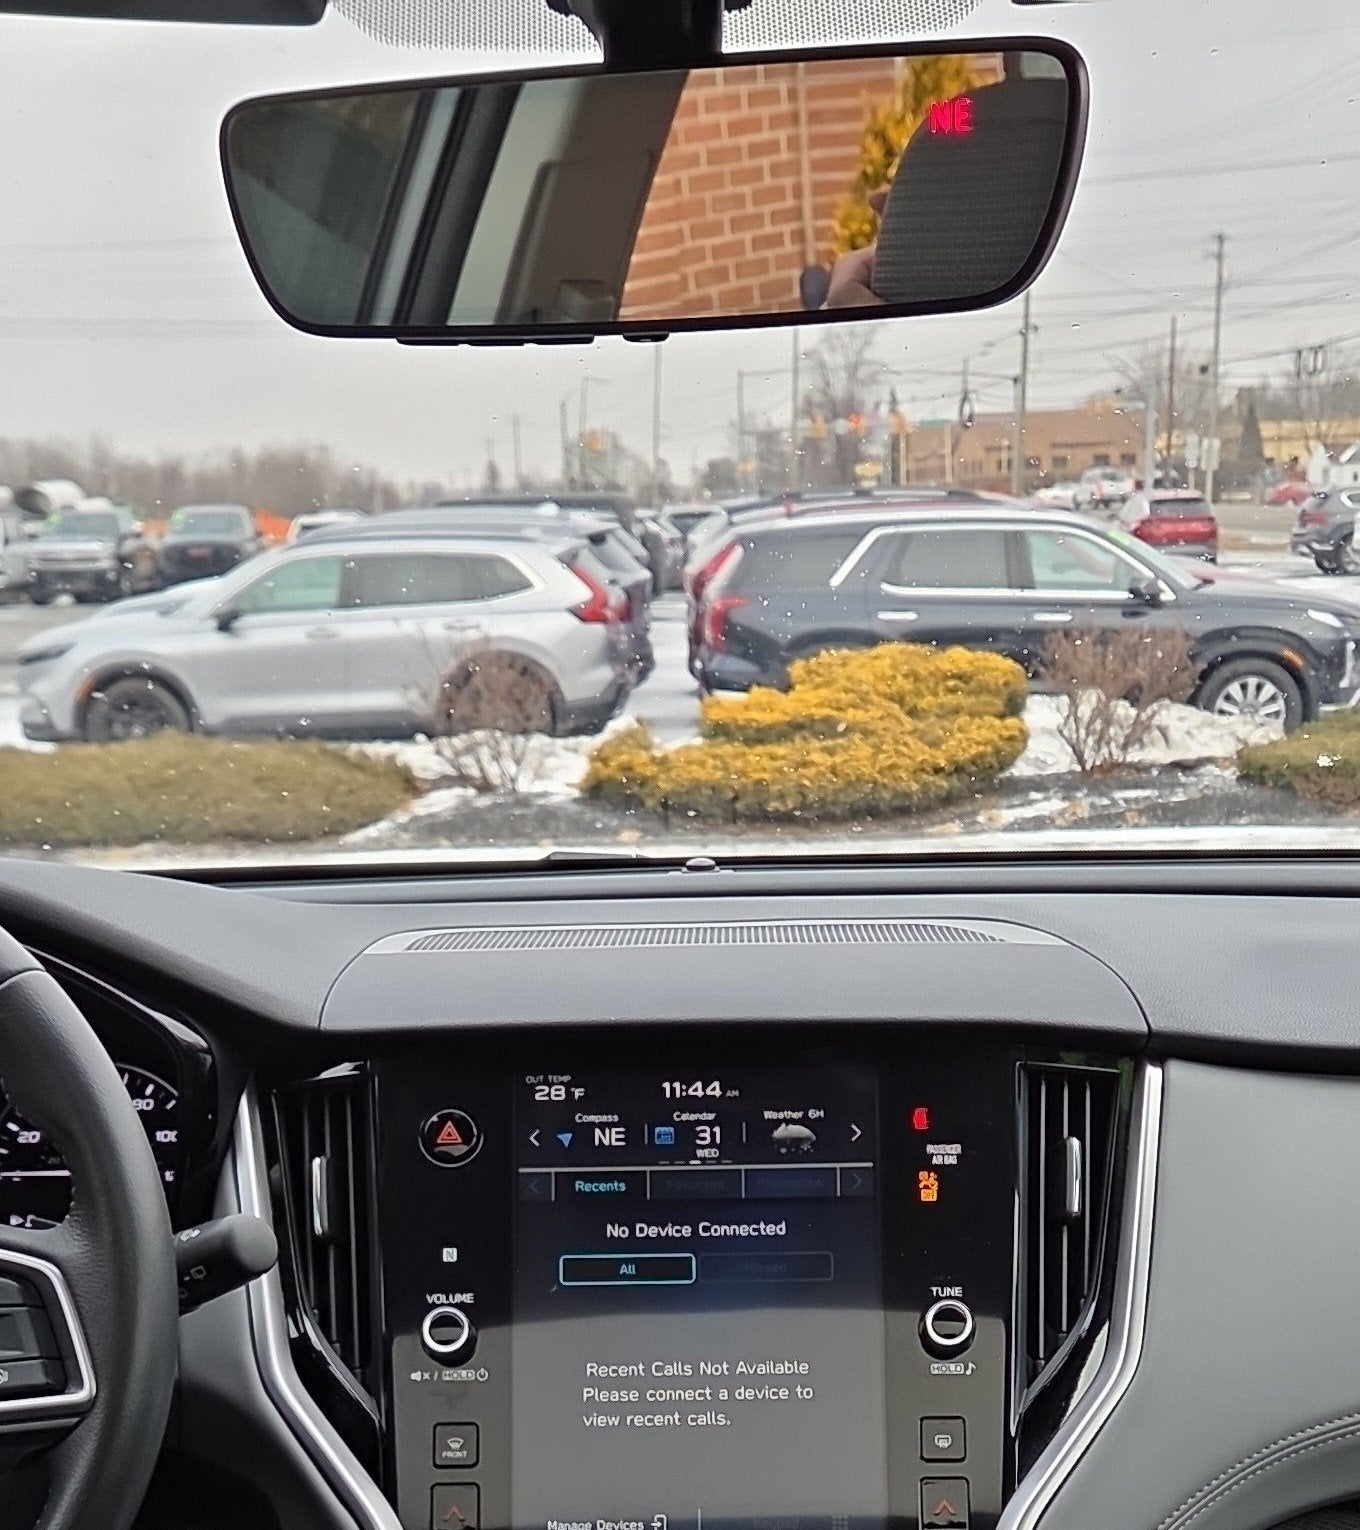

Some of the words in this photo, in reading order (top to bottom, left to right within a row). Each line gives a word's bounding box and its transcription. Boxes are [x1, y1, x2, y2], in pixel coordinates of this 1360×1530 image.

[930, 98, 972, 133] NE
[525, 1075, 544, 1084] OUT
[548, 1075, 571, 1083] TEMP
[534, 1085, 566, 1101] 28
[662, 1080, 723, 1098] 11:44
[725, 1090, 739, 1098] AM
[575, 1112, 619, 1123] Compass
[673, 1111, 716, 1122] Calendar
[763, 1110, 804, 1120] Weather
[808, 1109, 824, 1120] 6H
[17, 1131, 40, 1144] 20
[594, 1127, 627, 1146] NE
[695, 1125, 721, 1145] 31
[696, 1148, 720, 1158] WED
[575, 1180, 627, 1192] Recents
[606, 1223, 629, 1238] No
[635, 1222, 692, 1238] Device
[698, 1220, 787, 1237] Connected
[619, 1263, 636, 1275] All
[930, 1286, 963, 1297] TUNE
[426, 1293, 475, 1304] VOLUME
[586, 1362, 645, 1377] Recent
[651, 1361, 693, 1377] Calls
[699, 1361, 729, 1376] Not
[736, 1359, 810, 1375] Available
[582, 1387, 640, 1402] Please
[646, 1386, 712, 1401] connect
[718, 1388, 729, 1400] a
[735, 1385, 790, 1400] device
[796, 1384, 814, 1399] to
[582, 1413, 620, 1427] view
[626, 1411, 681, 1426] recent
[687, 1411, 732, 1426] calls.
